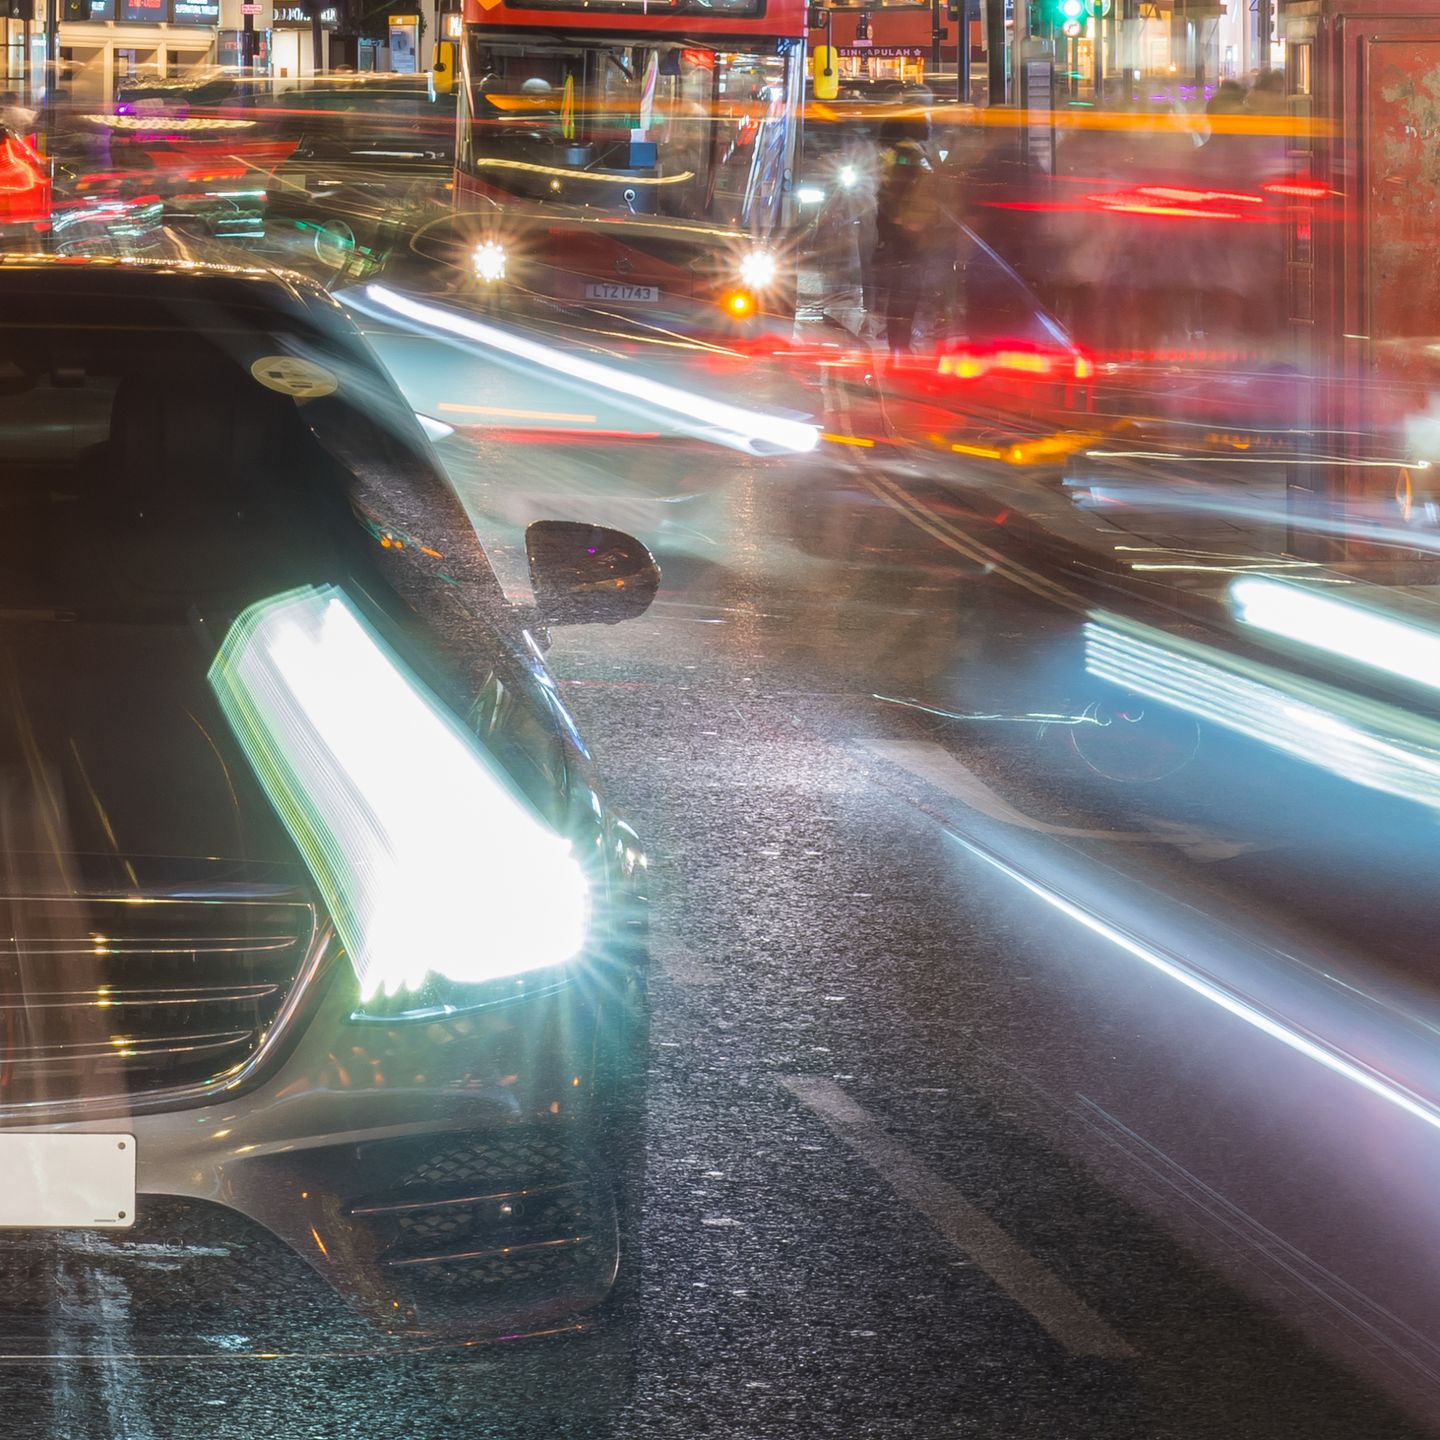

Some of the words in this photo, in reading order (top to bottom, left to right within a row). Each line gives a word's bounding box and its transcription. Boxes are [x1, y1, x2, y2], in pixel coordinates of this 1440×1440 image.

[840, 48, 911, 56] SINAPULAH
[593, 285, 618, 298] LTZ
[622, 286, 651, 300] 1743
